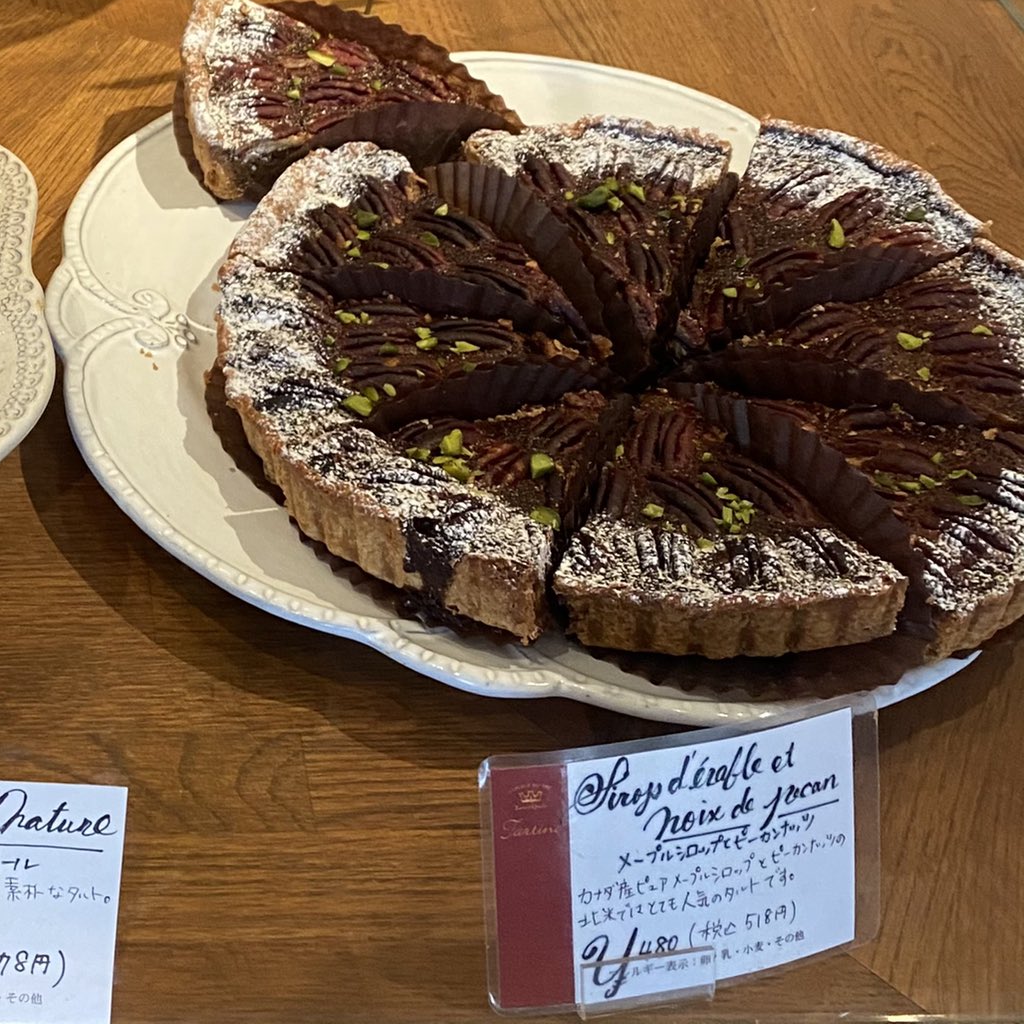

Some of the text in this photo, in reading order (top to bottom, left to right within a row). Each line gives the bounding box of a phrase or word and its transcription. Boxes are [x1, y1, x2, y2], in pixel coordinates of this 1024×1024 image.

[574, 756, 663, 817] Sirop
[771, 741, 796, 774] et
[730, 786, 755, 820] de
[617, 814, 816, 874] メープルシロップとピーカンナッツ
[577, 868, 796, 928] 北米ではとても人気のタルトです。
